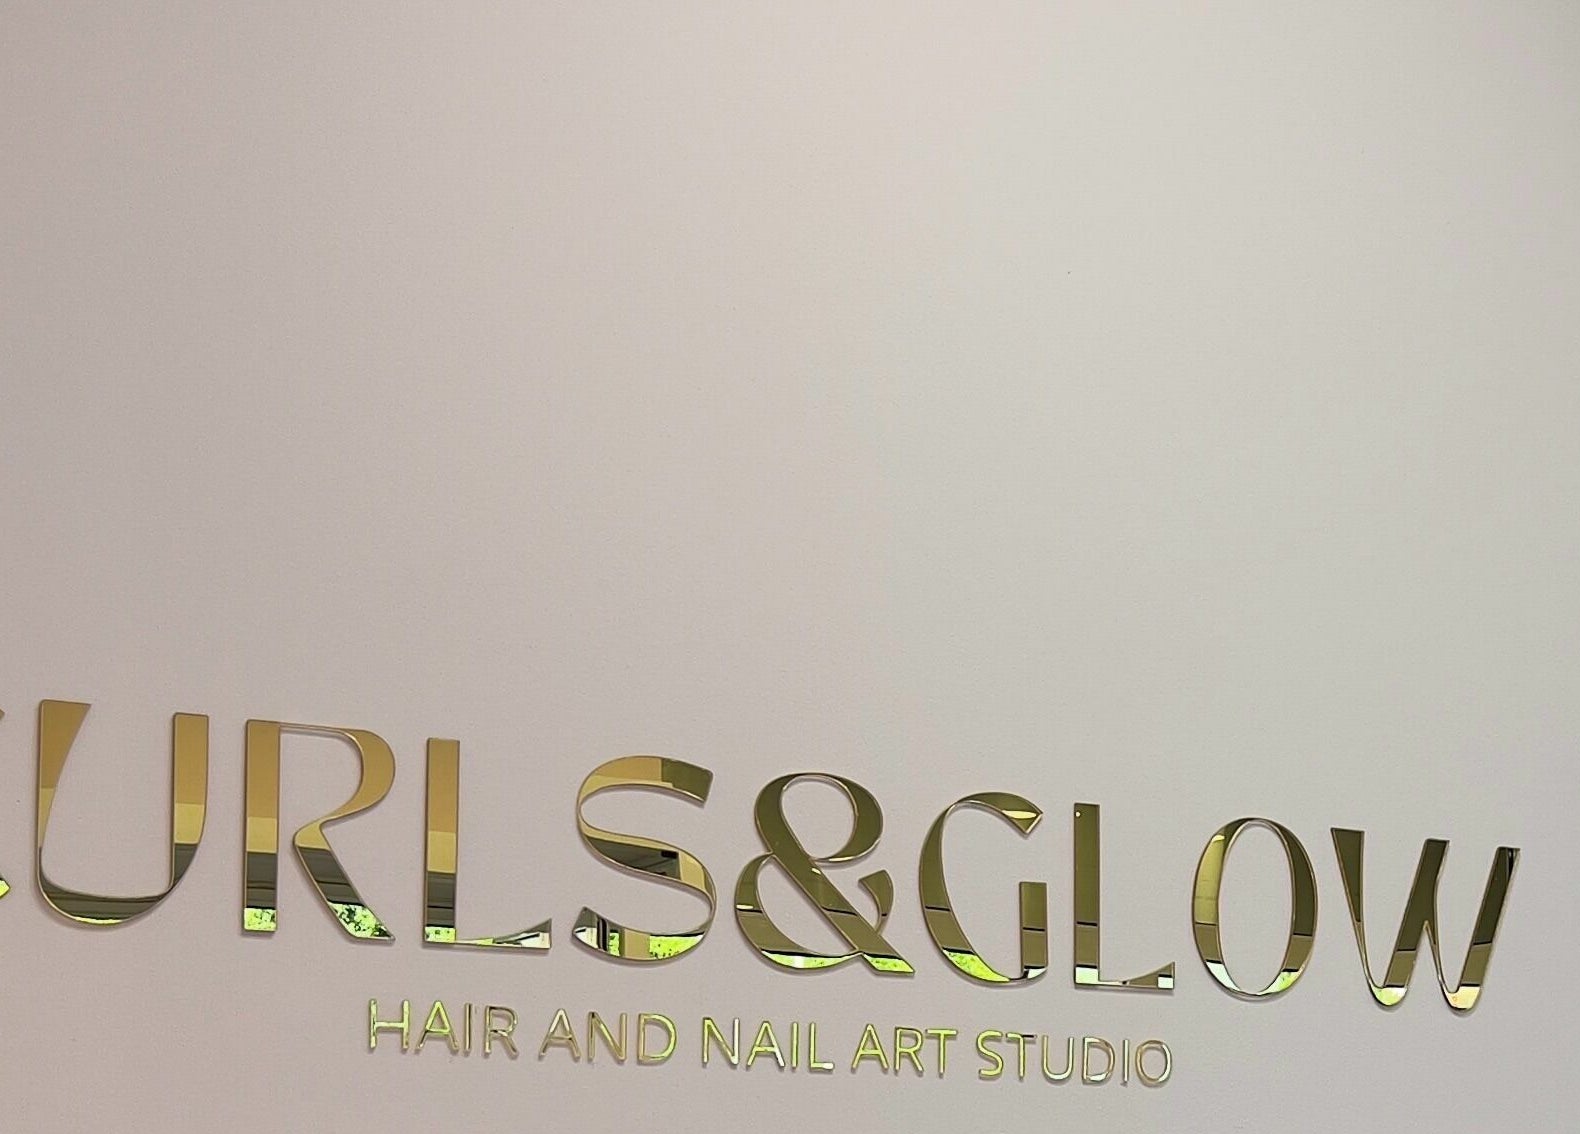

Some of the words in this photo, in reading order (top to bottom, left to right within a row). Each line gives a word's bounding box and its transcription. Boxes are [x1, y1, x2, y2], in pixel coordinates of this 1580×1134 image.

[0, 698, 1522, 1013] URLS&GLOW
[368, 999, 519, 1057] HAIR
[538, 1008, 678, 1064] AND
[701, 1017, 835, 1070] NAIL
[850, 1024, 959, 1077] ART
[974, 1030, 1173, 1085] STUDIO
